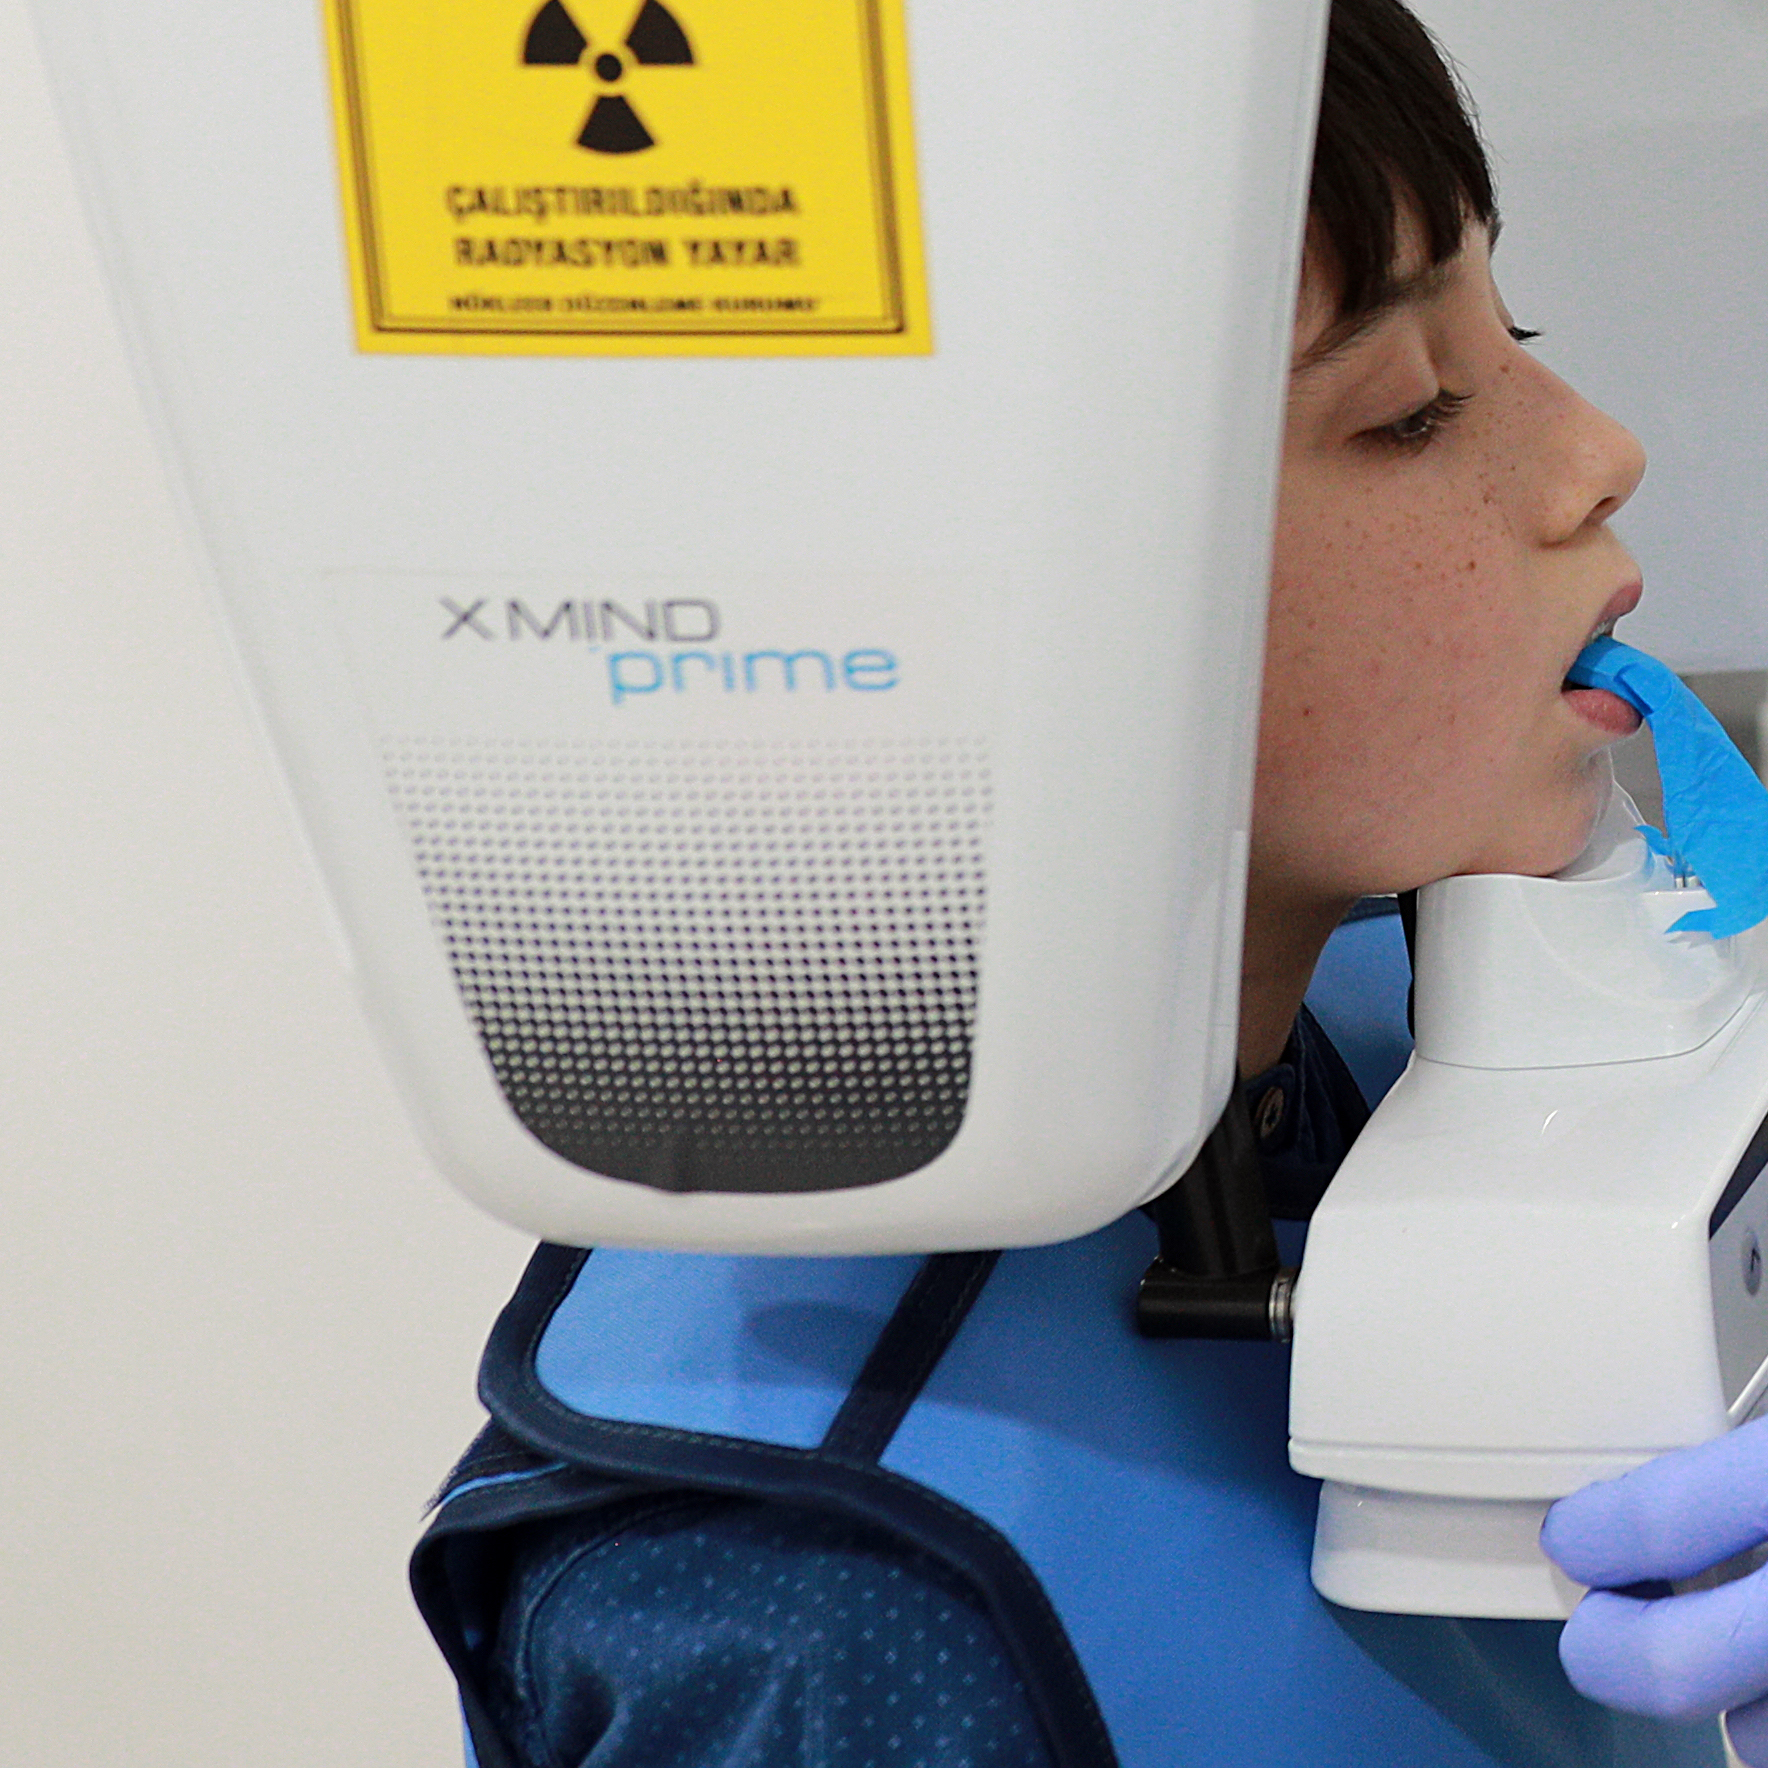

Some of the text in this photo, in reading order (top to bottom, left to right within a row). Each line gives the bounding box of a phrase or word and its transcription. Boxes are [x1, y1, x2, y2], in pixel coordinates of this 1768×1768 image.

[445, 178, 800, 224] ÇALIŞTIRILDIĞINDA
[453, 235, 803, 267] RADYASYON YAYAR
[606, 647, 900, 706] prime
